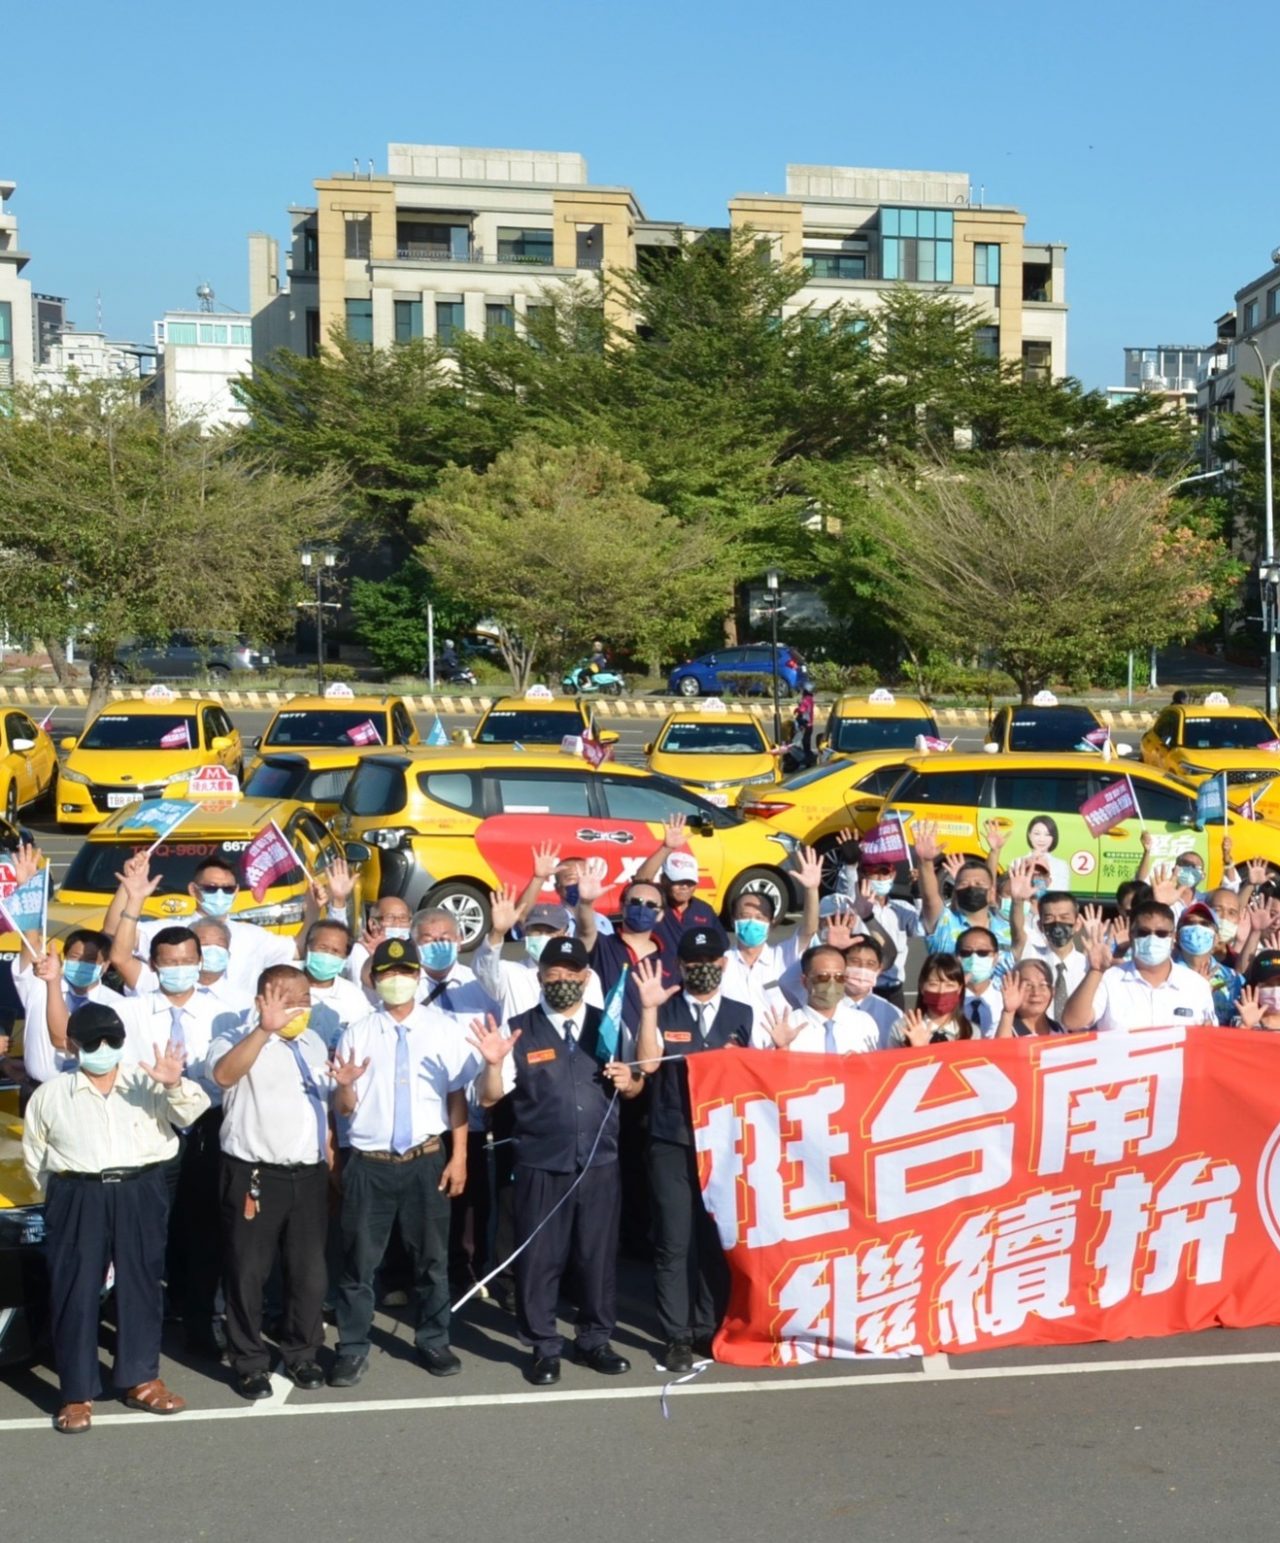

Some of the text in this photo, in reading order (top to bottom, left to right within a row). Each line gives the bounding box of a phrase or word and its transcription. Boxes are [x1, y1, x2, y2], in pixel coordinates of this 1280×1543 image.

[206, 768, 222, 779] M
[1077, 855, 1089, 871] 2
[693, 1025, 1186, 1250] 挺台南
[772, 1155, 1243, 1364] 繼續拚
